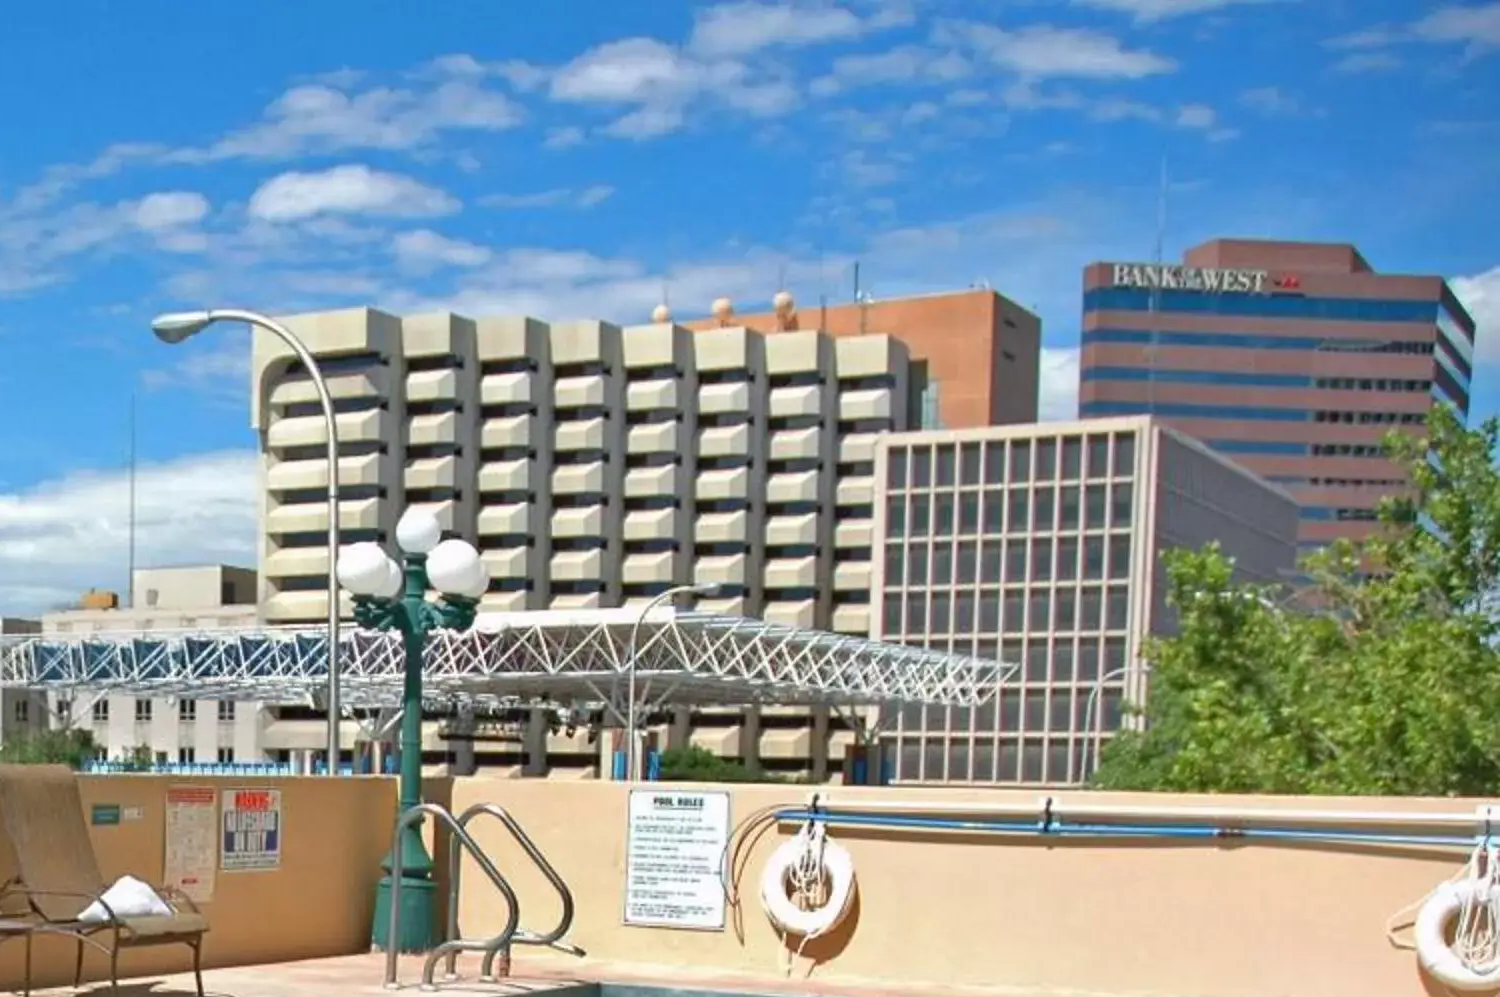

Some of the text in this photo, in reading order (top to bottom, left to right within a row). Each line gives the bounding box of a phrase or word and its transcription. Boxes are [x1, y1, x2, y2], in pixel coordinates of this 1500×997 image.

[1113, 264, 1177, 288] BANK
[1202, 268, 1267, 292] WEST
[653, 796, 704, 807] POOL RULES
